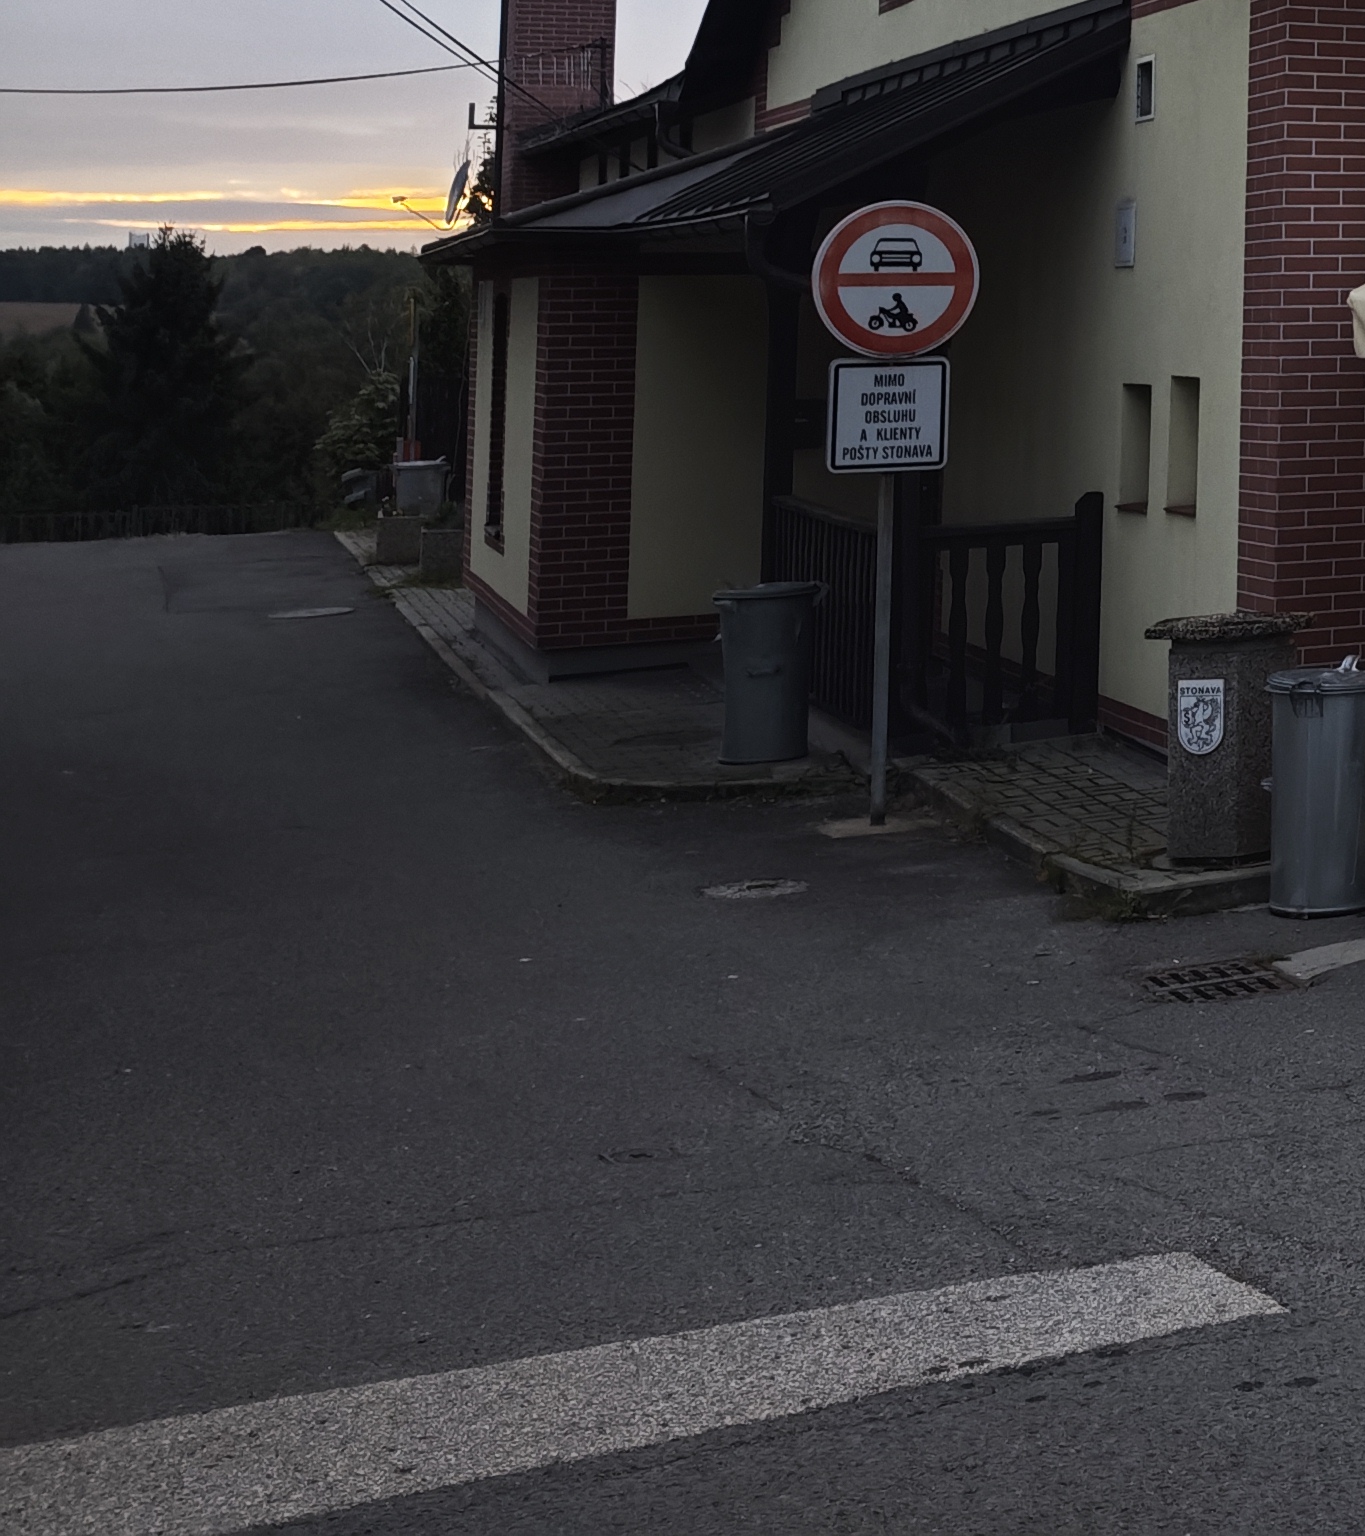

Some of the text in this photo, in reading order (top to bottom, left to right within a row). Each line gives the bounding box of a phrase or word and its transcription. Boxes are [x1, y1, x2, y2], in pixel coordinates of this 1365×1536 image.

[873, 372, 906, 388] MIMO
[860, 389, 917, 407] DOPRAVNÍ
[864, 408, 917, 425] OBSLUHU
[859, 426, 922, 443] A KLIENTY
[842, 444, 933, 461] POŠTY STONAVA
[1179, 686, 1221, 695] STONAVA
